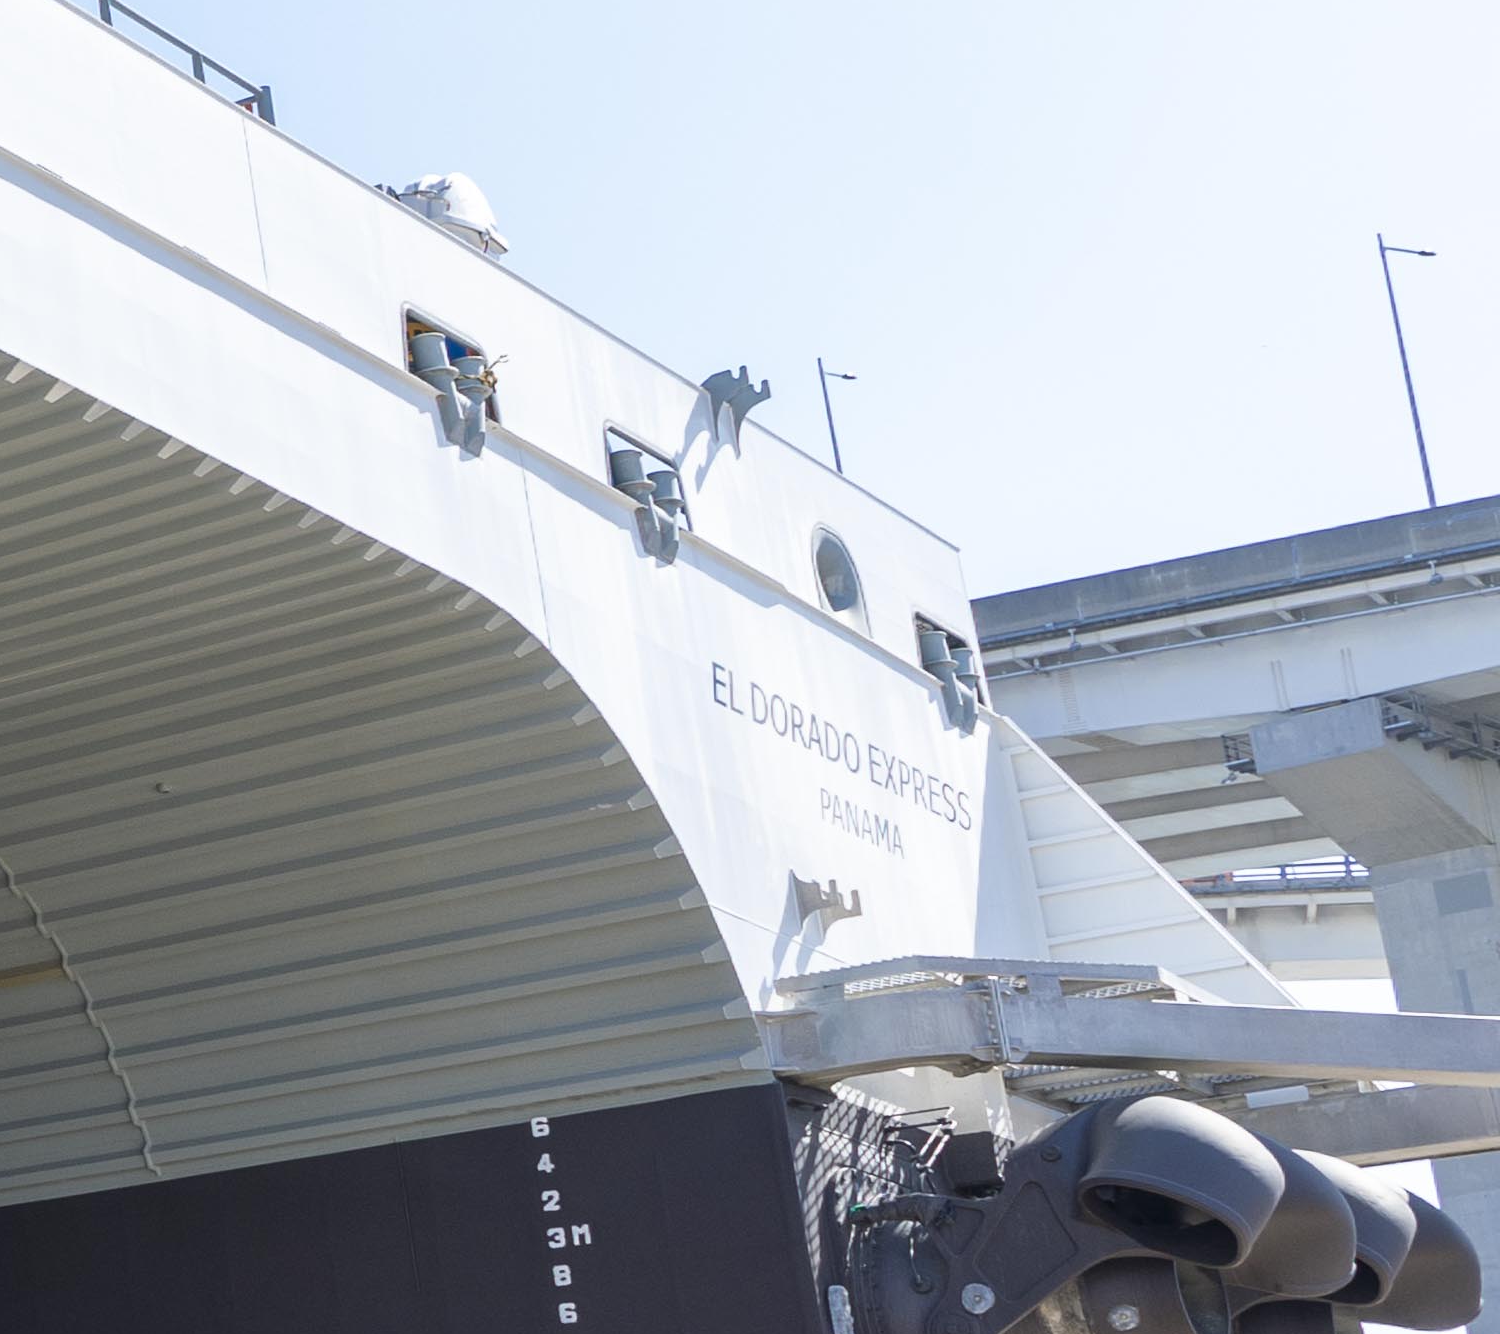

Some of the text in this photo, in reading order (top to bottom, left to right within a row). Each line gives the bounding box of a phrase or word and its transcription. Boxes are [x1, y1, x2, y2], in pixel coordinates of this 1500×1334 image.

[712, 662, 972, 831] EL DORADO EXPRESS
[820, 788, 905, 859] PANAMA
[531, 1117, 550, 1137] 6
[537, 1153, 555, 1173] 4
[541, 1190, 561, 1211] 2
[552, 1265, 572, 1286] 8
[559, 1303, 578, 1323] 6
